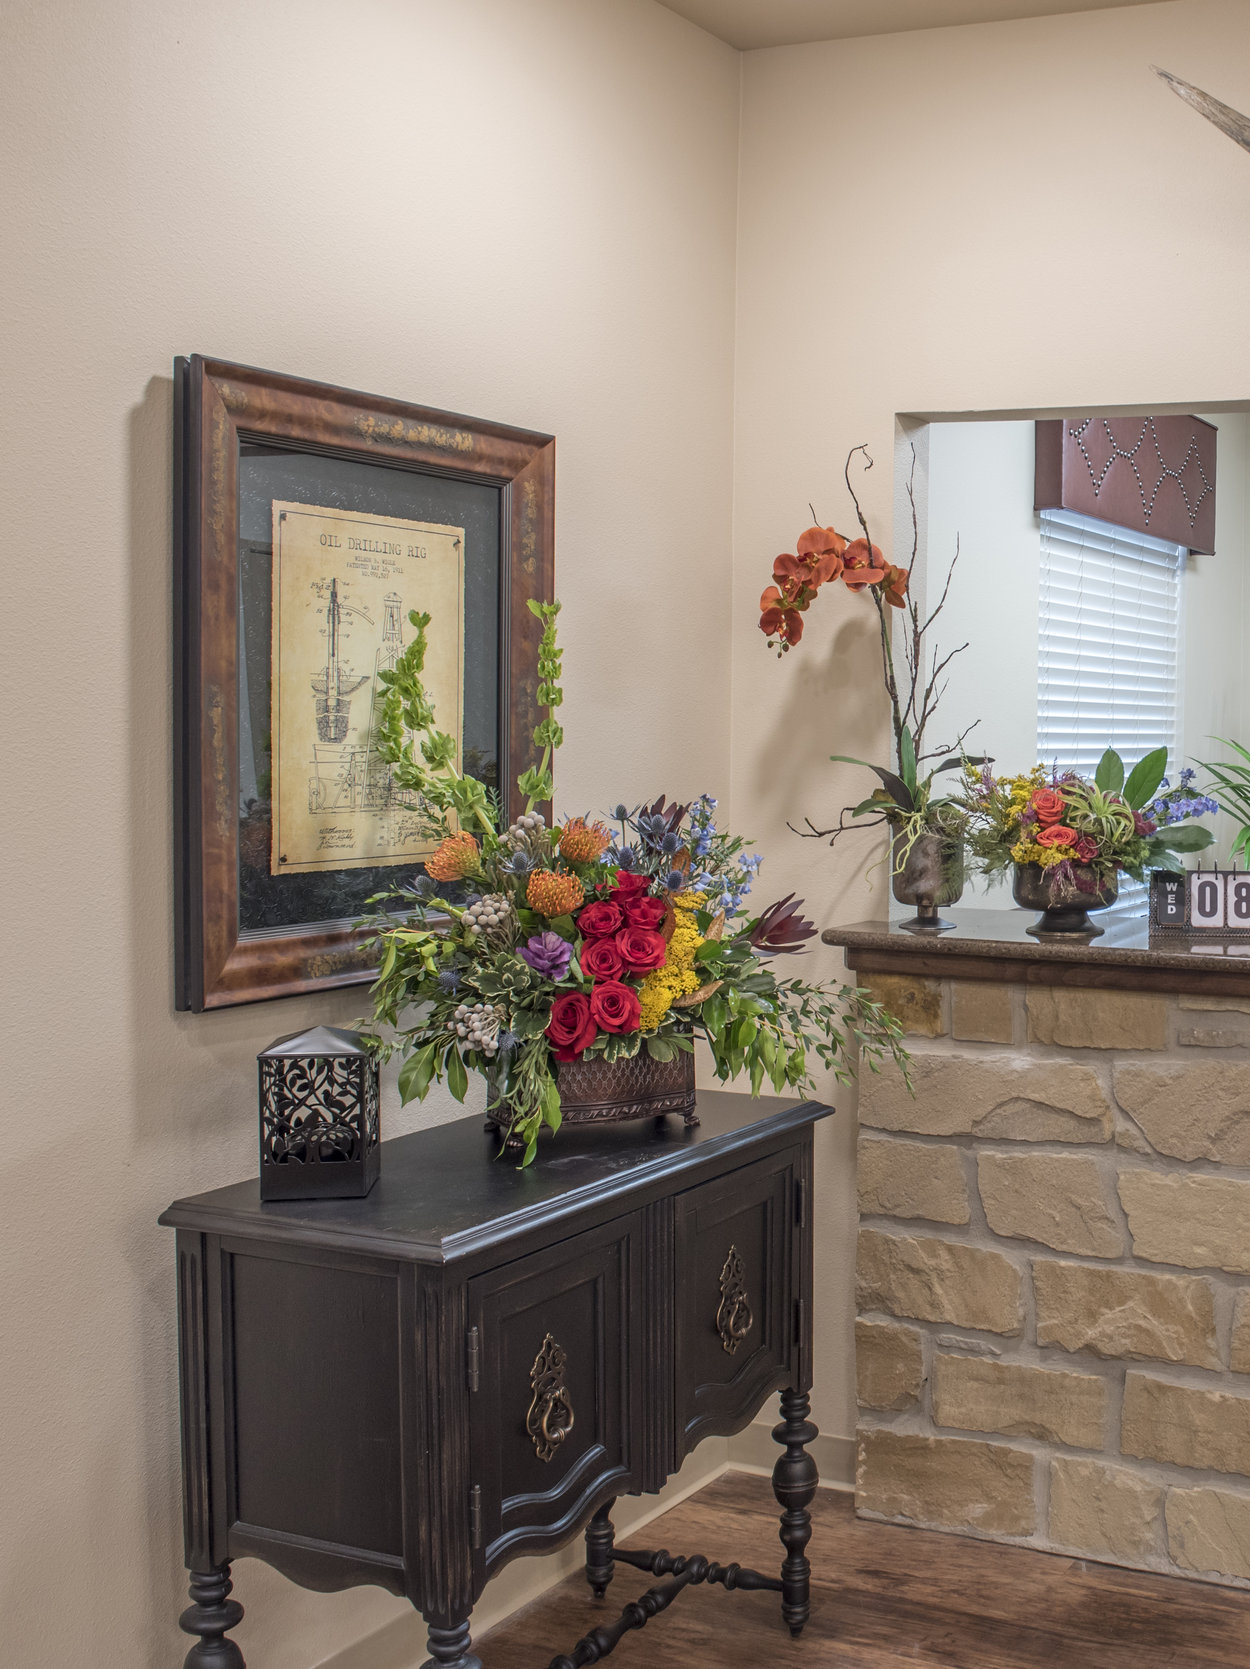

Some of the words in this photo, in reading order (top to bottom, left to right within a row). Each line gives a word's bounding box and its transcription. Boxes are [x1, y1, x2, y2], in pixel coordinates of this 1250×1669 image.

[319, 533, 341, 548] OIL
[347, 537, 402, 556] DRILLING
[407, 545, 427, 559] RIG
[346, 562, 369, 570] PATENTED
[1166, 882, 1178, 915] WED
